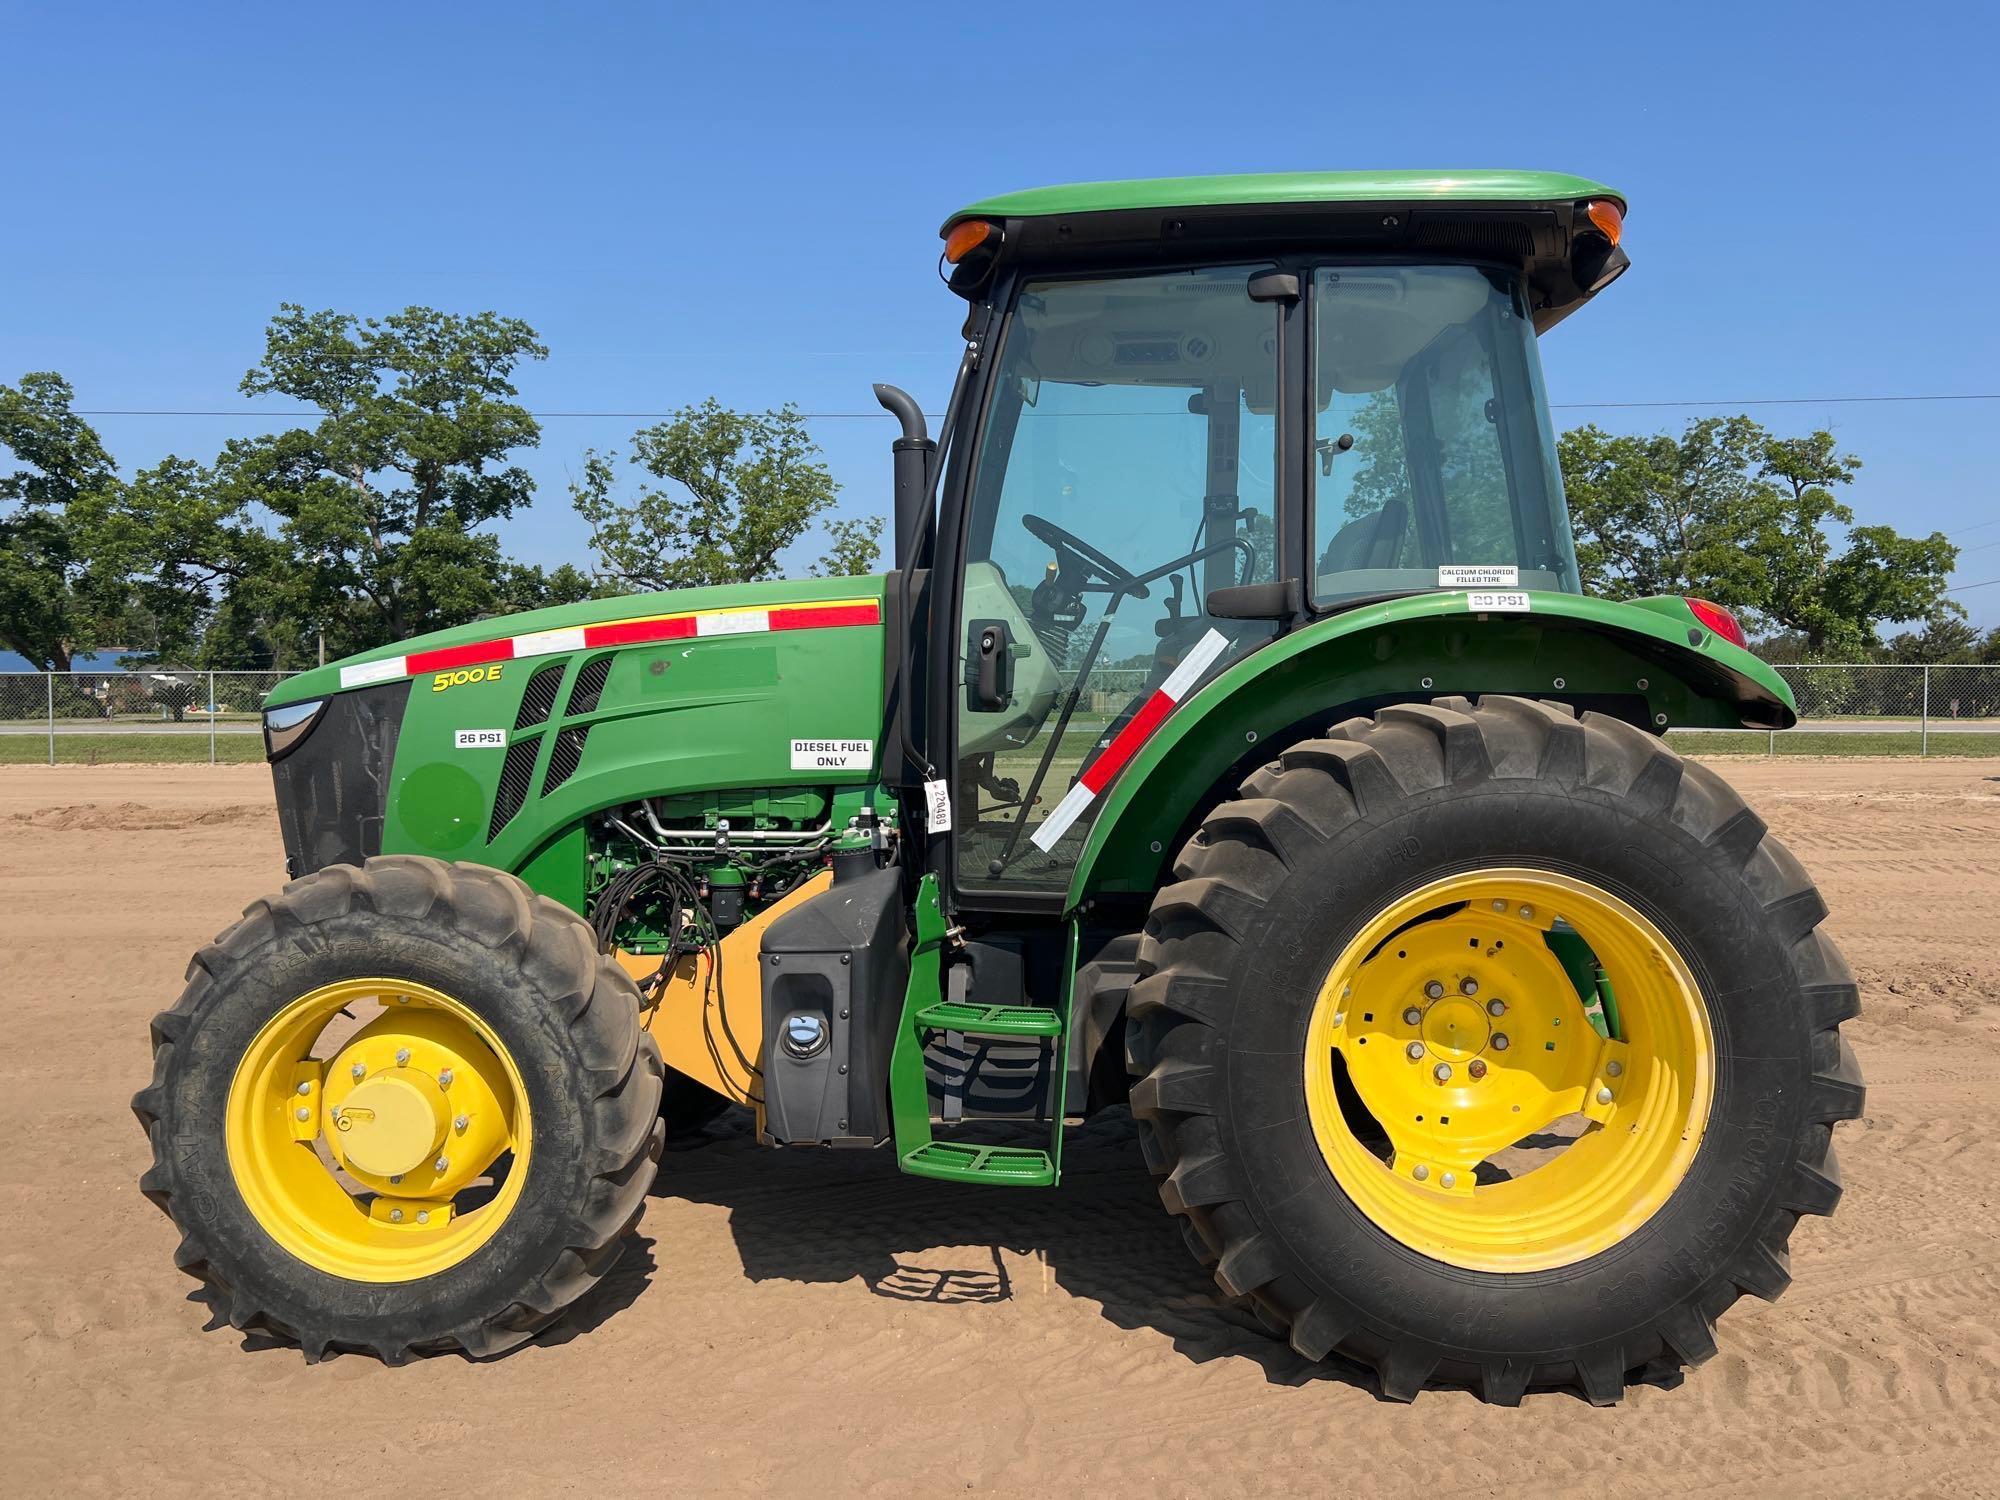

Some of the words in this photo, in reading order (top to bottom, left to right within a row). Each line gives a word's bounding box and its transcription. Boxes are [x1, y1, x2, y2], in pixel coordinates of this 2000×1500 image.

[1497, 596, 1525, 606] PSI
[460, 733, 476, 743] 26
[479, 733, 502, 743] PSI
[794, 742, 838, 752] DIESEL
[841, 742, 869, 752] FUEL
[817, 757, 847, 766] ONLY
[934, 790, 947, 825] 220489
